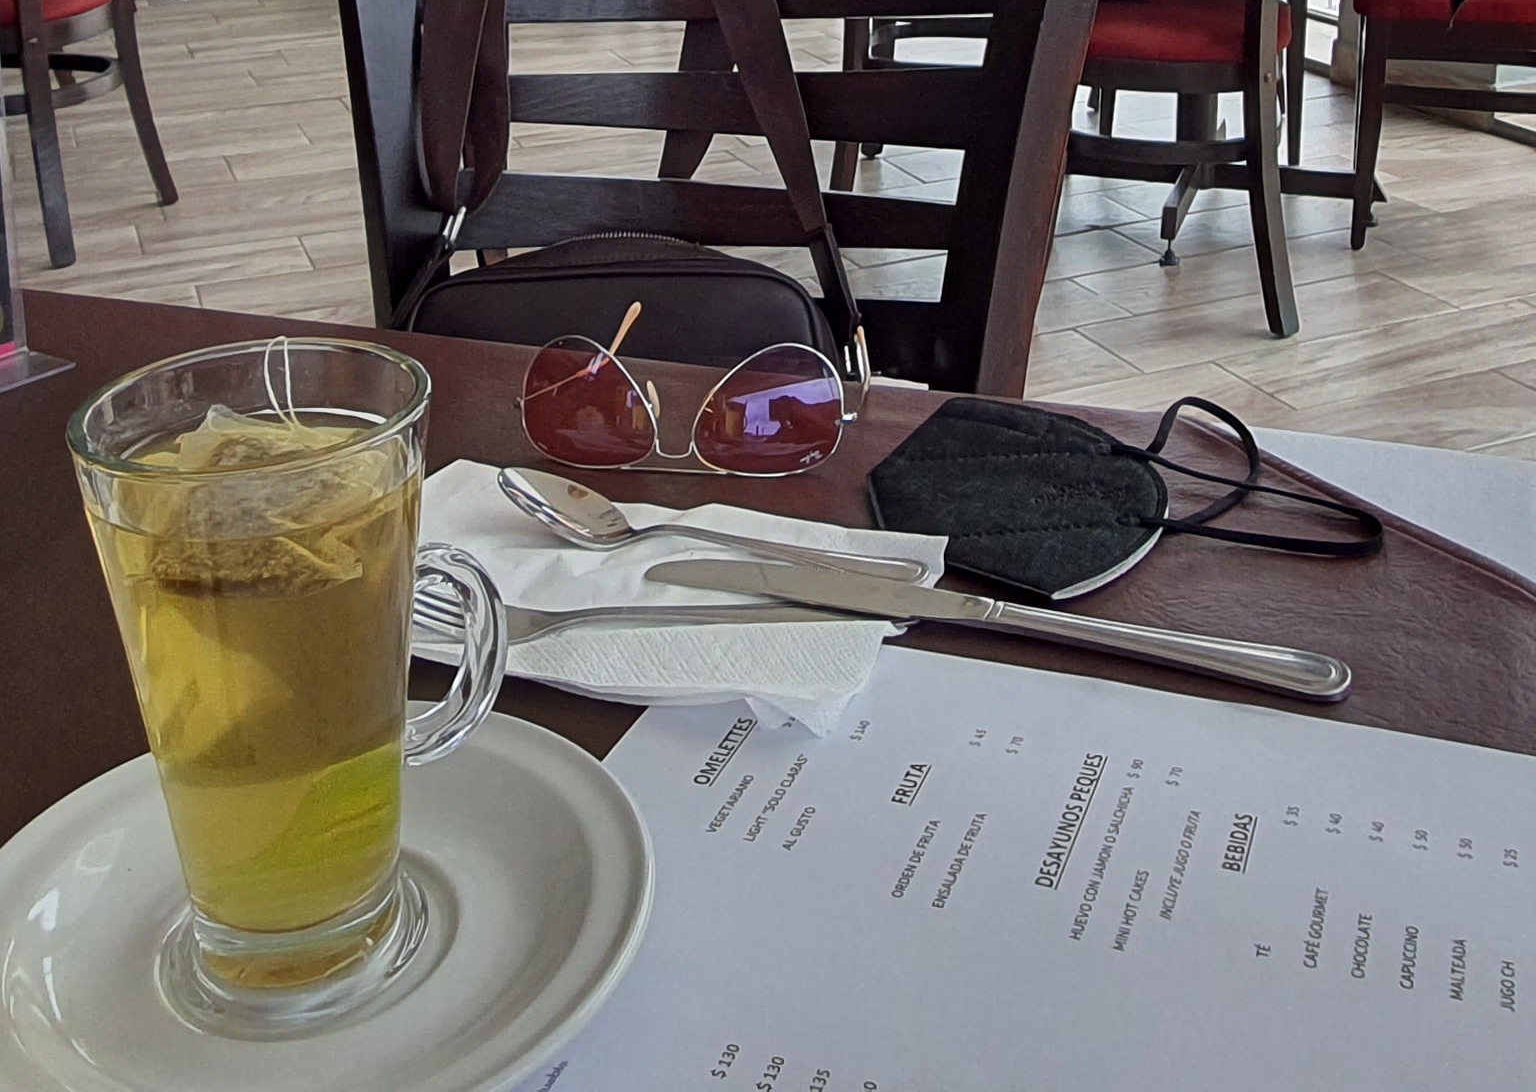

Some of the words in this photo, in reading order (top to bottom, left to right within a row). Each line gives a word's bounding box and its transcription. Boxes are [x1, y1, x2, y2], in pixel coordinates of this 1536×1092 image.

[694, 718, 754, 786] OMELETTES
[891, 763, 928, 805] FRUTA
[705, 774, 755, 834] VEGETARIANO
[1107, 786, 1134, 835] SALCHICHA
[743, 815, 768, 842] LIGHT
[782, 838, 797, 851] AL
[790, 806, 816, 838] GUSTO
[917, 819, 941, 849] FRUTA
[964, 812, 987, 843] FRUTA
[1034, 803, 1083, 889] DESAYUNOS
[1070, 753, 1104, 802] PEQUES
[1182, 810, 1201, 840] FRUTA
[957, 842, 972, 857] DE
[1104, 835, 1116, 844] O
[1180, 840, 1192, 849] O
[1221, 813, 1254, 873] BEBIDAS
[910, 850, 925, 864] DE
[1092, 844, 1113, 880] JAMON
[1173, 849, 1190, 877] JUGO
[891, 864, 917, 898] ORDEN
[932, 857, 966, 909] ENSALADA
[1083, 880, 1101, 903] CON
[1129, 869, 1150, 902] CAKES
[1159, 875, 1182, 921] INCLUYE
[1309, 887, 1329, 939] GOURMET
[1069, 903, 1093, 941] HUEVO
[1124, 903, 1139, 926] HOT
[1112, 925, 1130, 952] MINI
[1254, 943, 1272, 957] TÉ
[1303, 939, 1320, 969] CAFÉ
[1351, 913, 1373, 979] CHOCOLATE
[1399, 925, 1419, 990] CAPUCCINO
[1449, 938, 1467, 1001] MALTEADA
[1501, 960, 1515, 978] CH
[1500, 979, 1515, 1012] JUGO
[718, 1043, 740, 1069] 130
[763, 1056, 785, 1081] 130
[809, 1068, 831, 1092] 135
